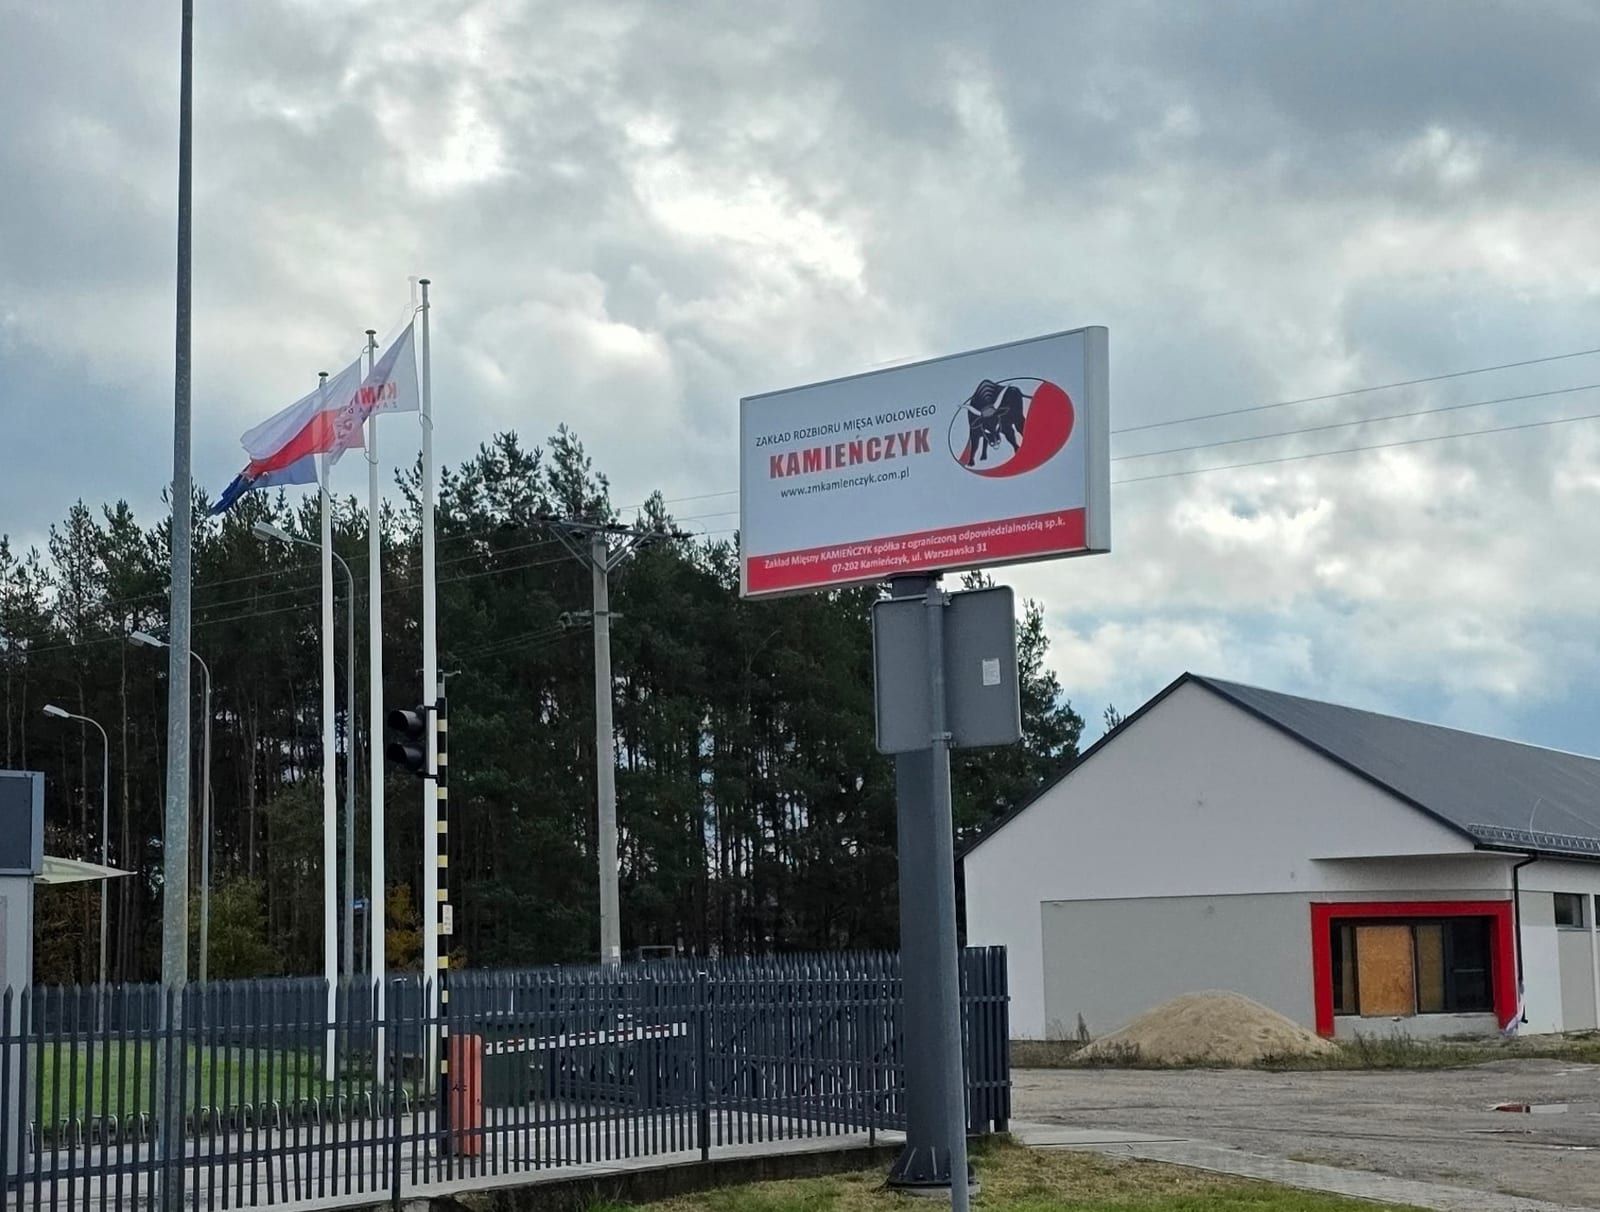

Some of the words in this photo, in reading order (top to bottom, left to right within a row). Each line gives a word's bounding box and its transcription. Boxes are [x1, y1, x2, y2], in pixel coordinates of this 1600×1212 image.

[756, 432, 791, 447] ZAKŁAD
[794, 423, 841, 441] ROZBIORU
[843, 417, 873, 431] MIĘSA
[875, 404, 937, 425] WOŁOWEGO
[770, 427, 931, 479] KAMIEŃCZYK
[781, 467, 910, 498] www.zmkamienczyk.com.pl
[765, 557, 790, 569] Zakład
[791, 554, 818, 566] Mięsny
[820, 545, 873, 561] KAMIEŃCZYK
[874, 541, 900, 555] spółka
[907, 533, 957, 550] ograniczoną
[958, 519, 1043, 542] odpowiedzialnością
[1044, 516, 1066, 530] sp.k.
[832, 563, 858, 574] 07-202
[912, 552, 922, 562] ul.
[924, 544, 975, 560] Warszawska
[976, 543, 987, 553] 31
